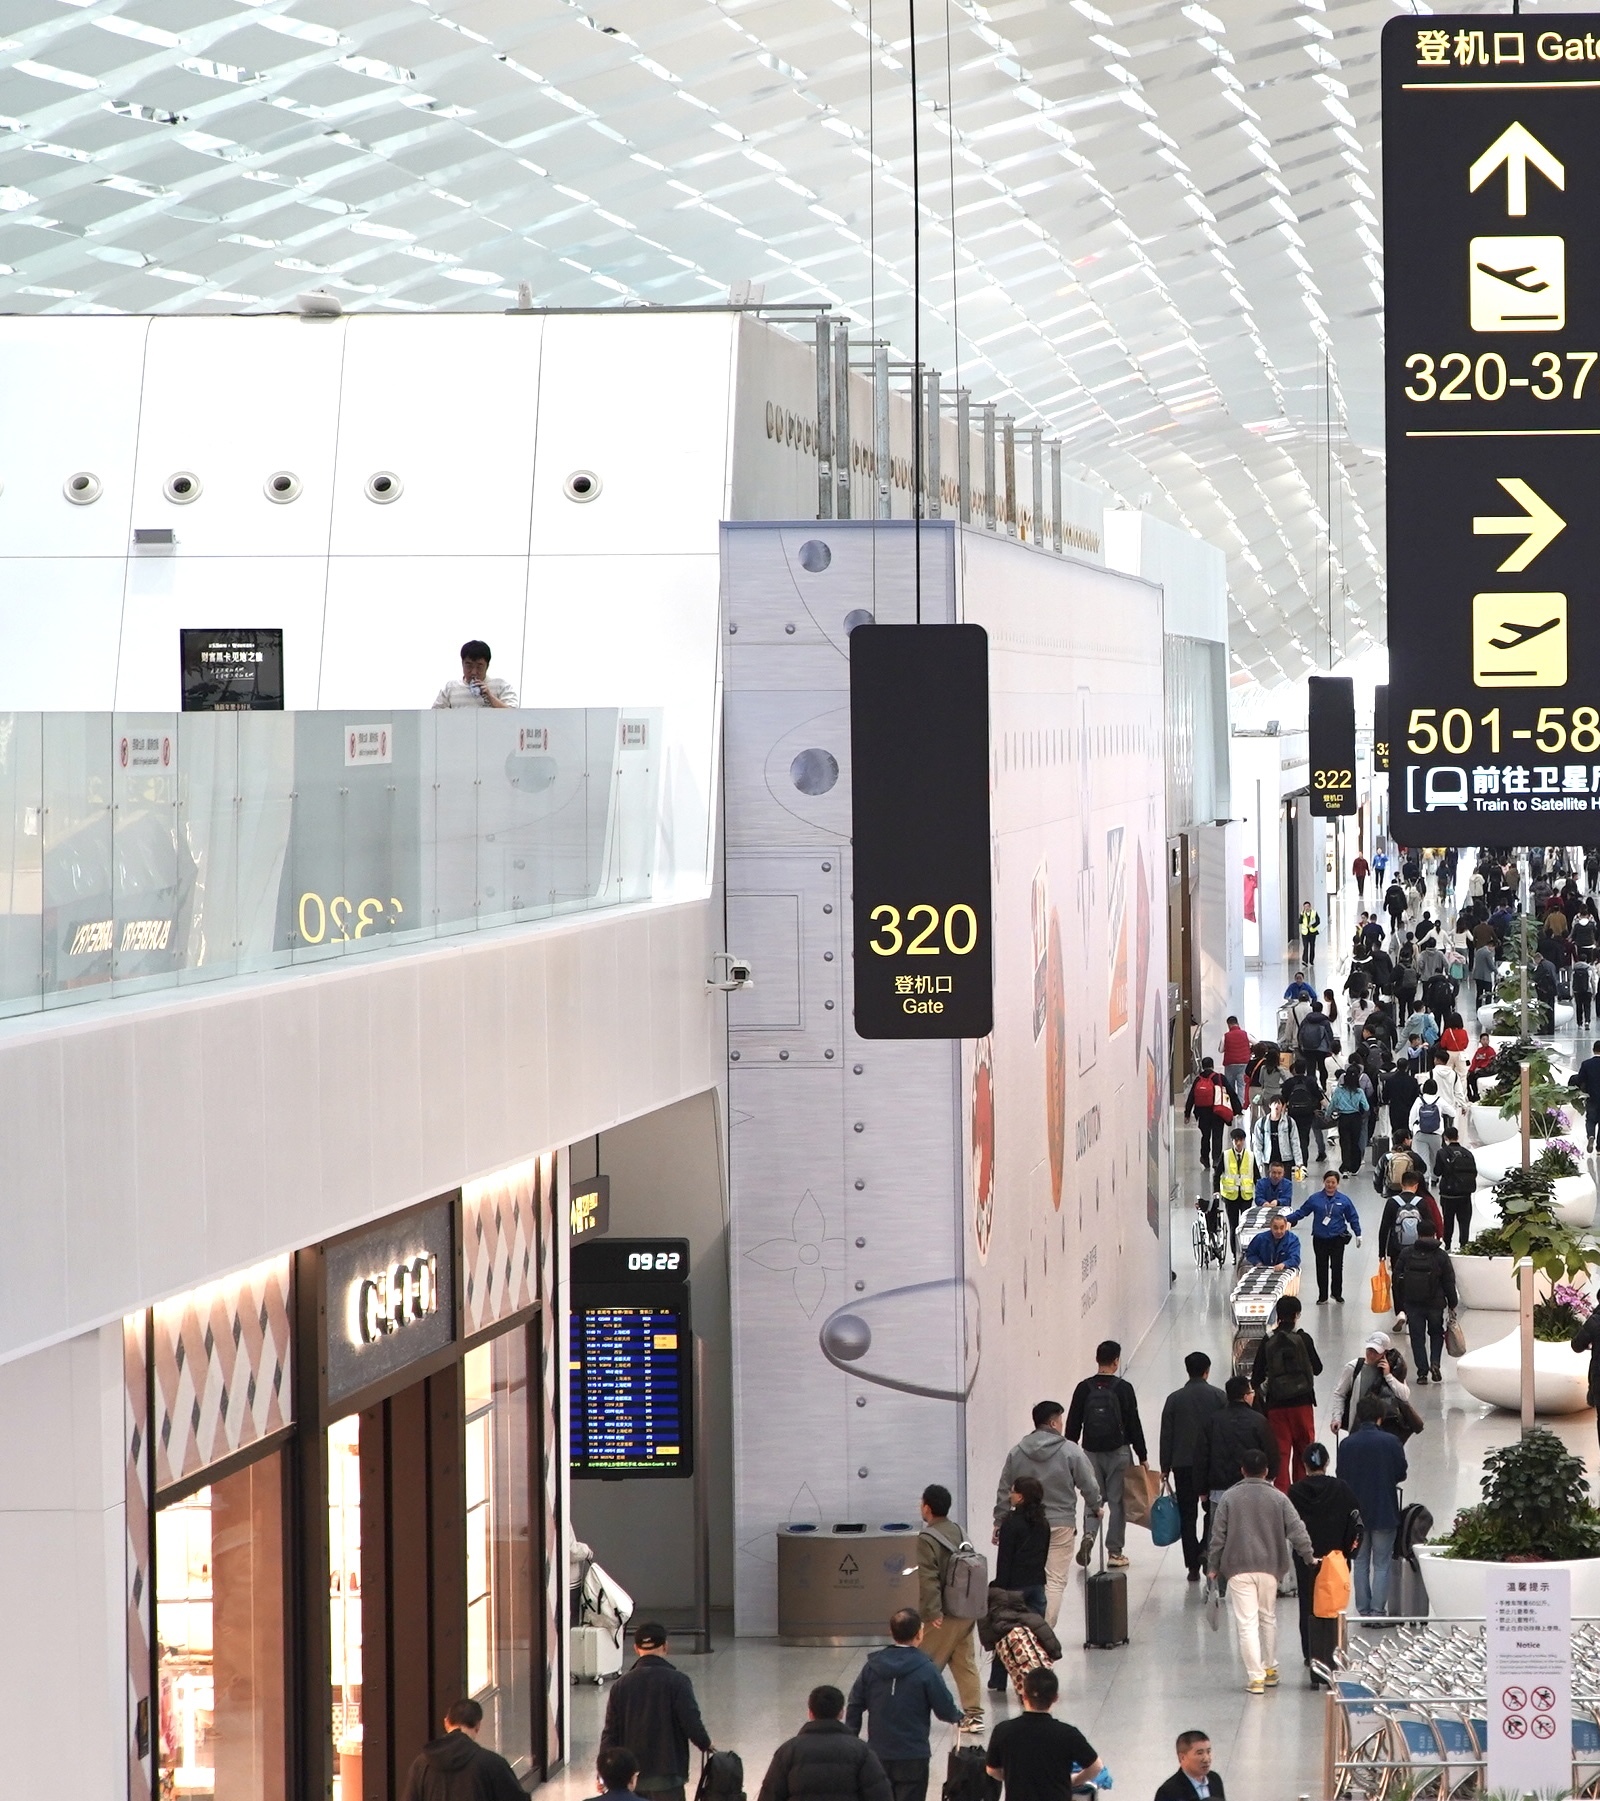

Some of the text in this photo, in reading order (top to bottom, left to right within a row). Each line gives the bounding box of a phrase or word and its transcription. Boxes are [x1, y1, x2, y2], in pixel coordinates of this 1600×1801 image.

[1415, 29, 1525, 66] 登机口
[1314, 770, 1352, 789] 322
[1473, 797, 1510, 811] Train
[1513, 799, 1528, 811] to
[1531, 797, 1587, 811] Satellite
[869, 903, 978, 956] 320
[894, 975, 952, 995] 登机口
[903, 998, 944, 1014] Gate
[1507, 1582, 1550, 1592] 温馨提示
[1516, 1641, 1541, 1649] Notice
